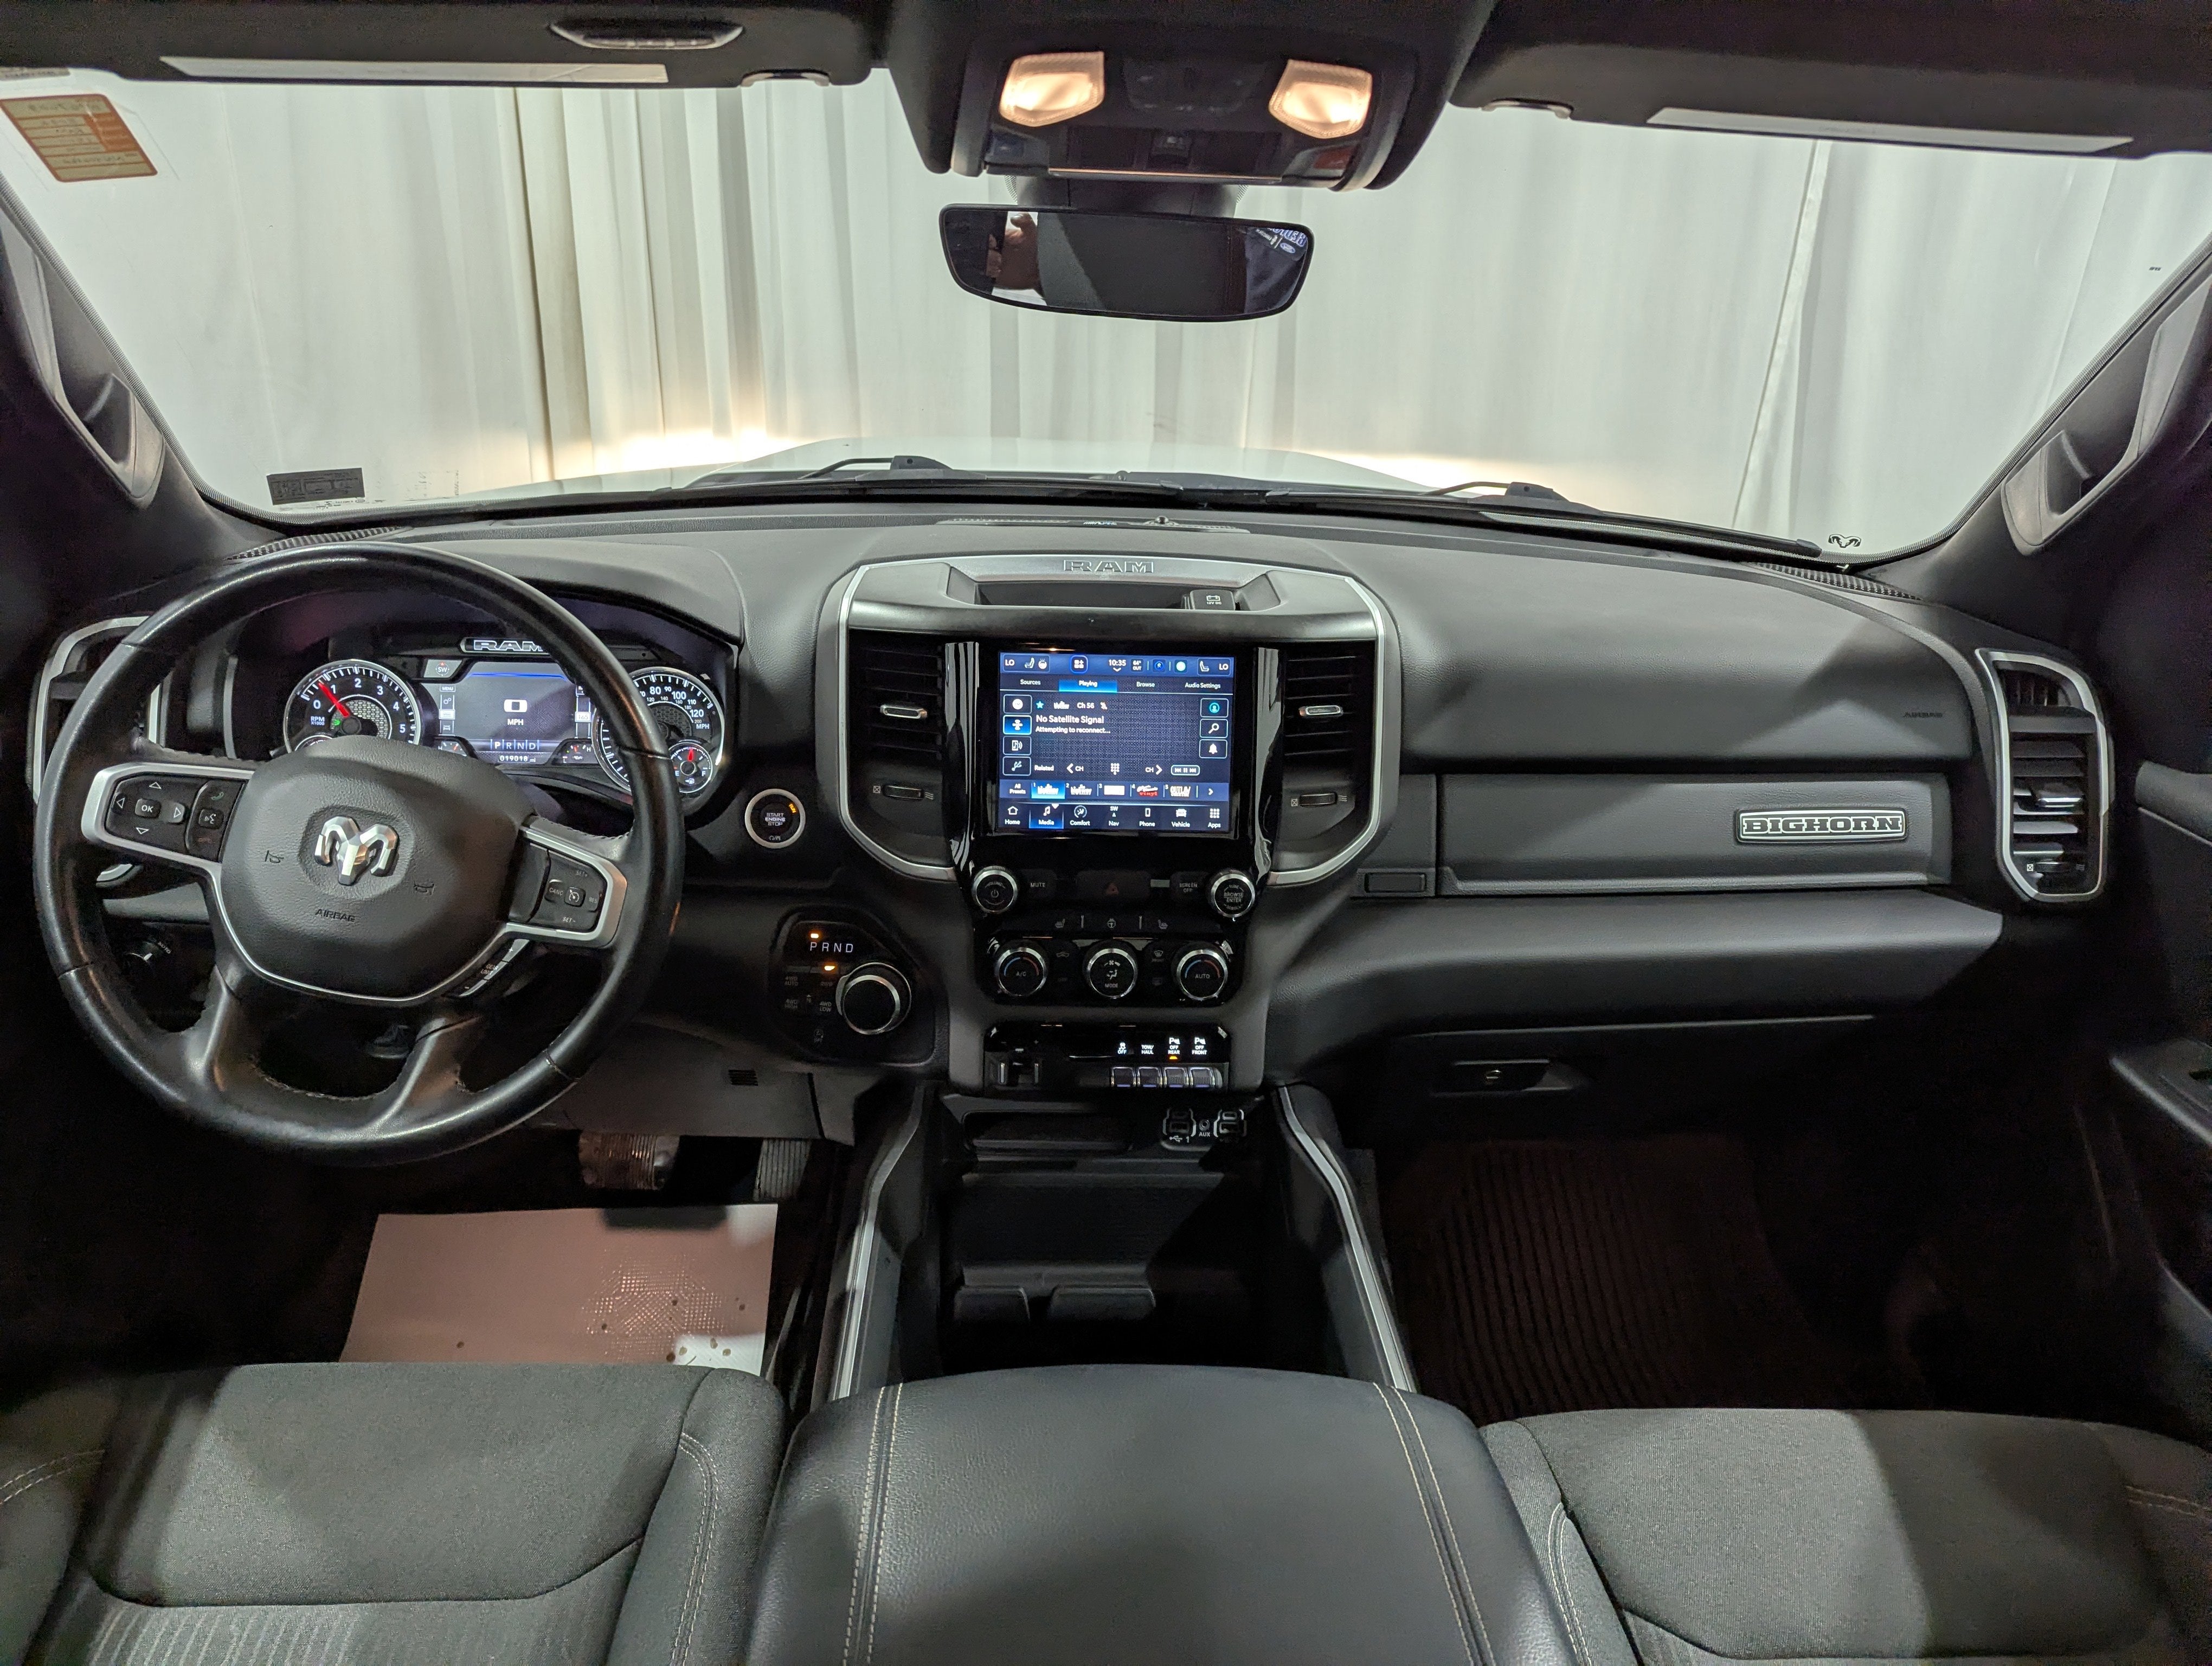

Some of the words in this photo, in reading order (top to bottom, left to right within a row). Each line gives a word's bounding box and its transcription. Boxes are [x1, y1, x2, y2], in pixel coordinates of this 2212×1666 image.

[1064, 559, 1154, 573] RAM
[474, 640, 543, 651] RAM
[355, 678, 362, 688] 2
[330, 685, 336, 694] 1
[377, 685, 383, 695] 3
[650, 687, 661, 695] 80
[672, 691, 686, 700] 100
[313, 700, 321, 709] 0
[393, 702, 400, 711] 4
[690, 709, 704, 717] 120
[1036, 715, 1047, 723] No
[1049, 715, 1079, 723] Satellite
[1081, 716, 1104, 725] Signal
[400, 724, 406, 733] 5
[1036, 726, 1068, 734] Attempting
[142, 805, 153, 813] OK
[788, 803, 796, 813] RUN
[1742, 816, 1902, 834] BIGHORN
[315, 909, 356, 922] AIRBAG
[810, 941, 817, 951] P
[822, 942, 829, 952] R
[834, 943, 841, 953] N
[846, 943, 853, 953] D
